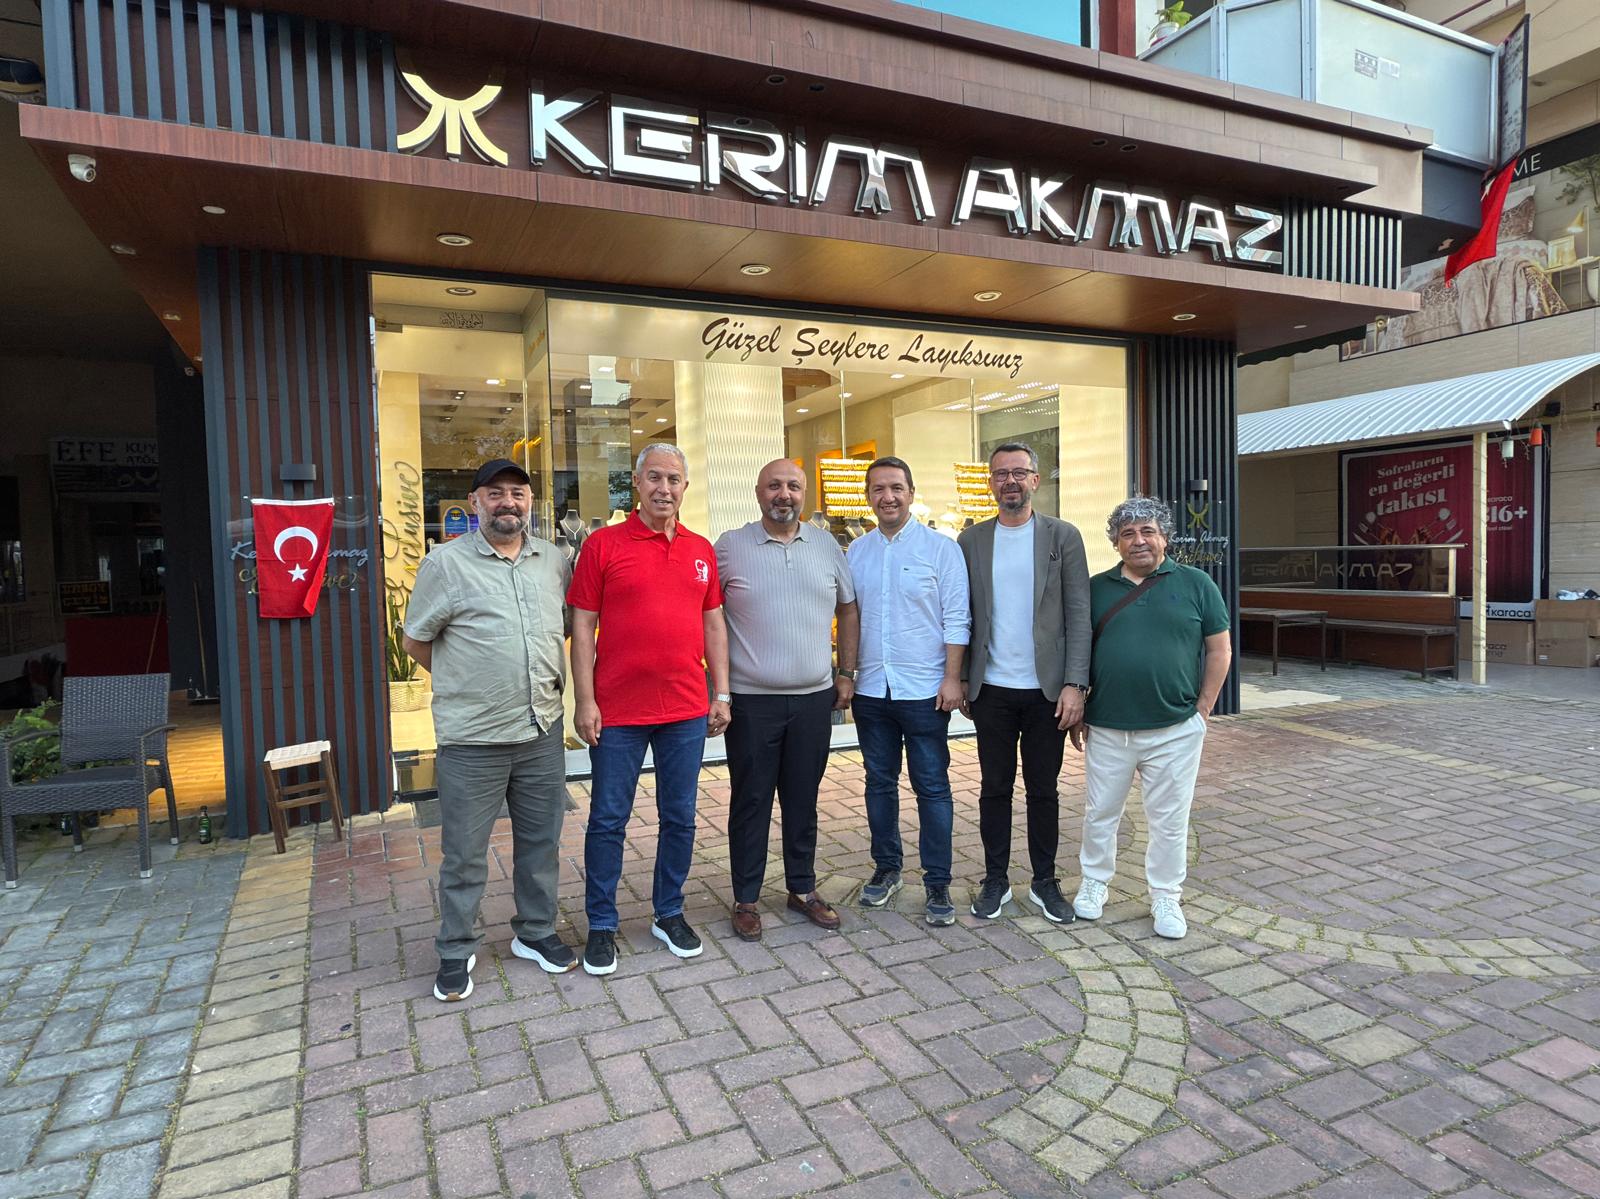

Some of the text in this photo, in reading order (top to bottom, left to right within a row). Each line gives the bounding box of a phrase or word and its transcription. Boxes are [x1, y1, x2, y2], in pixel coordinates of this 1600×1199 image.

[952, 156, 1284, 268] AKMAZ
[701, 317, 1024, 379] Güzel Şeylere Layıksınız
[57, 441, 117, 462] EFE
[1368, 464, 1455, 497] en değerli
[1377, 455, 1444, 479] Sofraların
[1376, 488, 1447, 516] takısı
[1491, 608, 1531, 618] karaca
